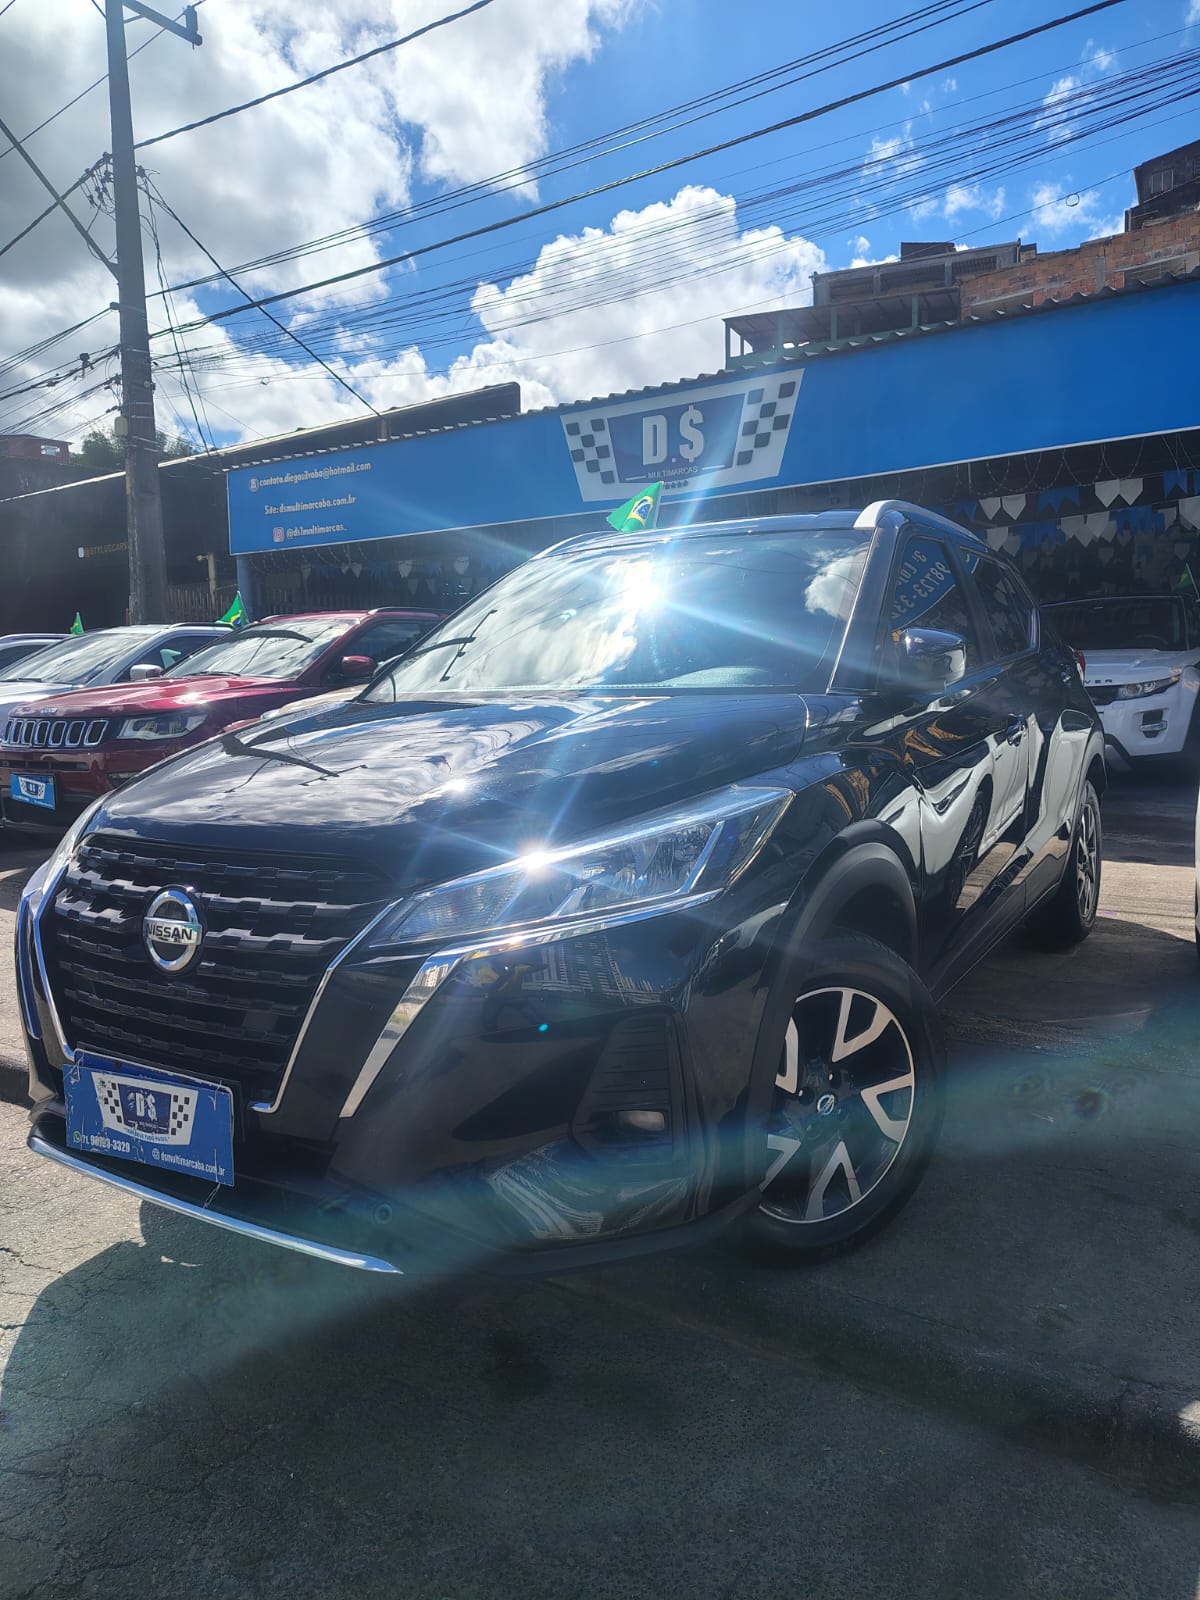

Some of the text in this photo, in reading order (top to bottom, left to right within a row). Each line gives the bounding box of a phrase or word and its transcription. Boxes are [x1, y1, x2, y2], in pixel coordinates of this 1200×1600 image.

[259, 462, 372, 487] contato.diegosilvaba@hotmail.com
[648, 465, 698, 478] MULTIMARCAS
[264, 504, 279, 515] Site:
[145, 922, 193, 941] NISSAN
